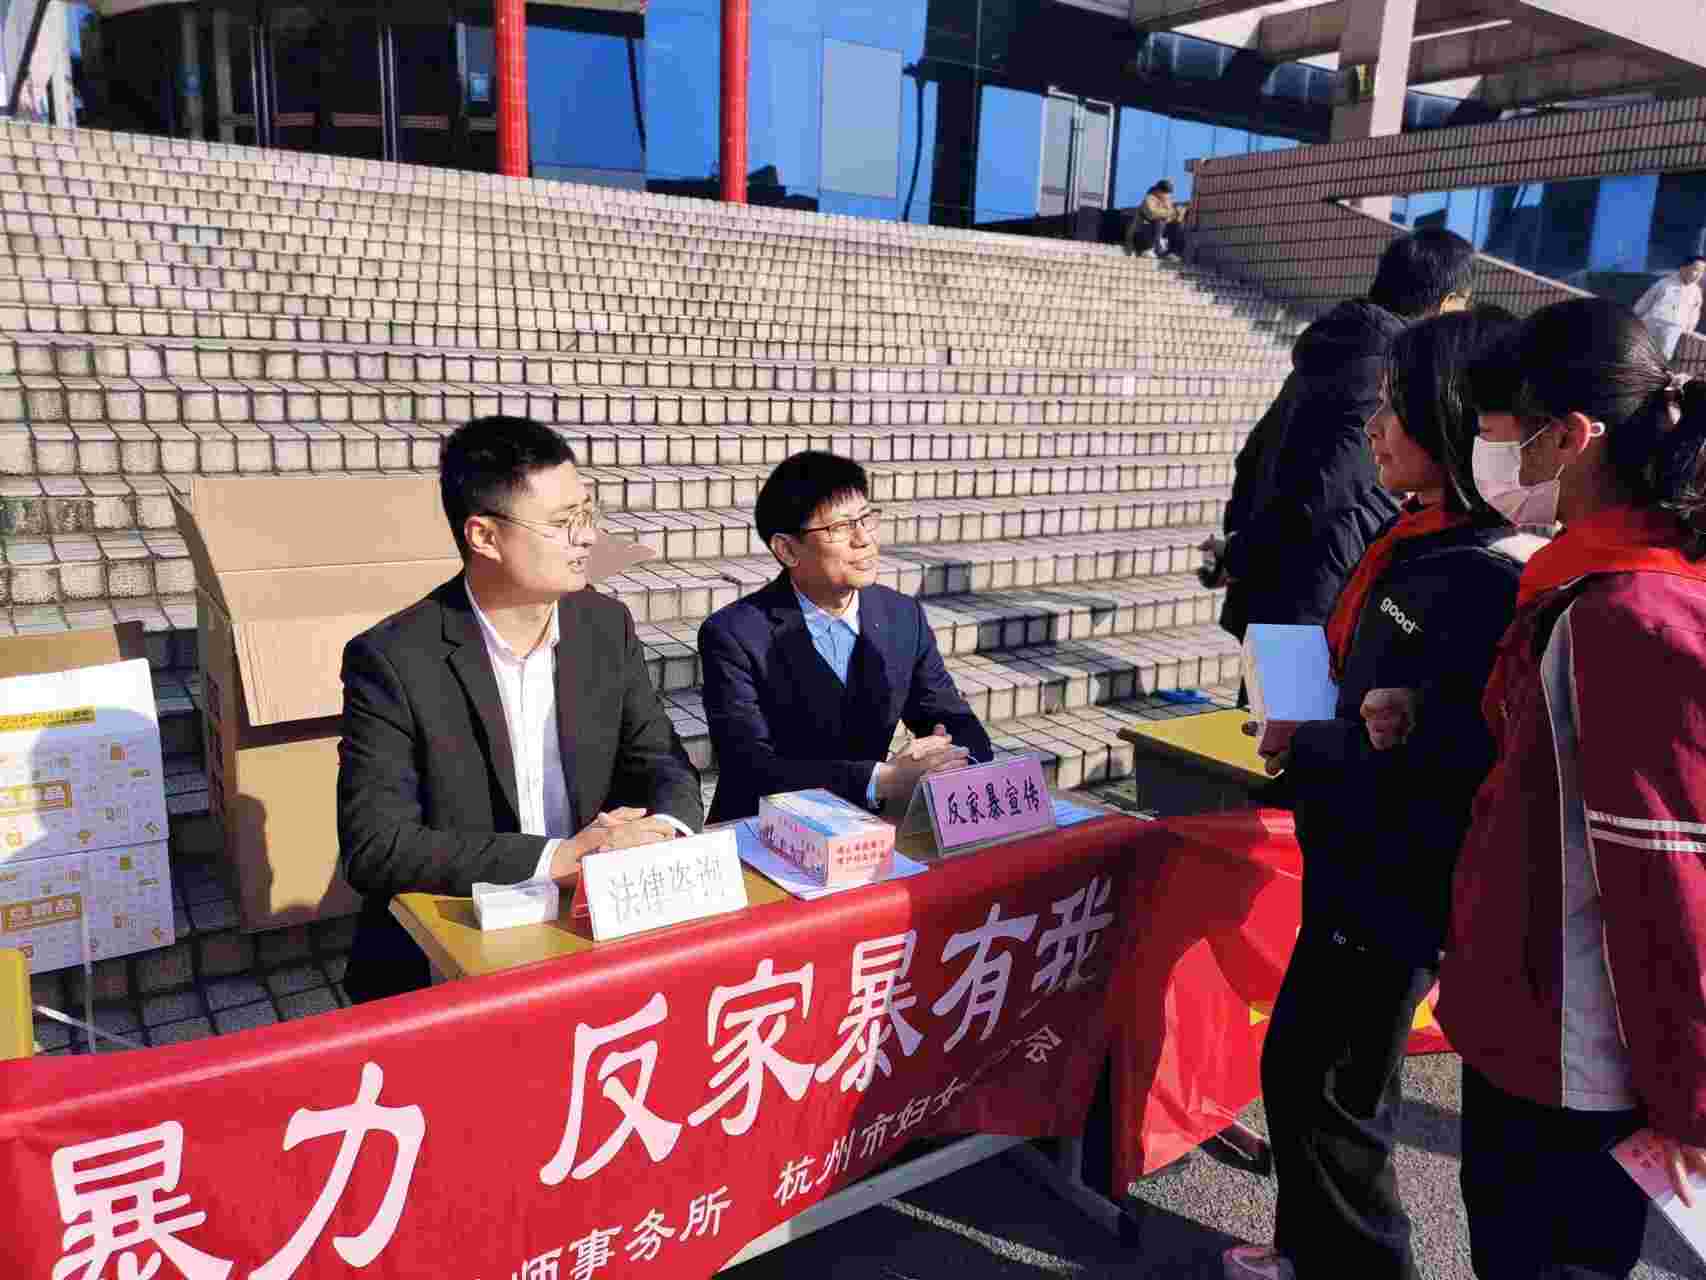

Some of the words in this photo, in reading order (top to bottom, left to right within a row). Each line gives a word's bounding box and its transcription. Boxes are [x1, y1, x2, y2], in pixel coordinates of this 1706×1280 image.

[1380, 597, 1416, 634] good
[946, 775, 1041, 825] 反家暴宣传
[51, 1061, 427, 1280] 暴力
[539, 876, 1114, 1186] 反家暴有我
[474, 1185, 733, 1280] 师事务所
[772, 1024, 1063, 1207] 杭州市妇女会
